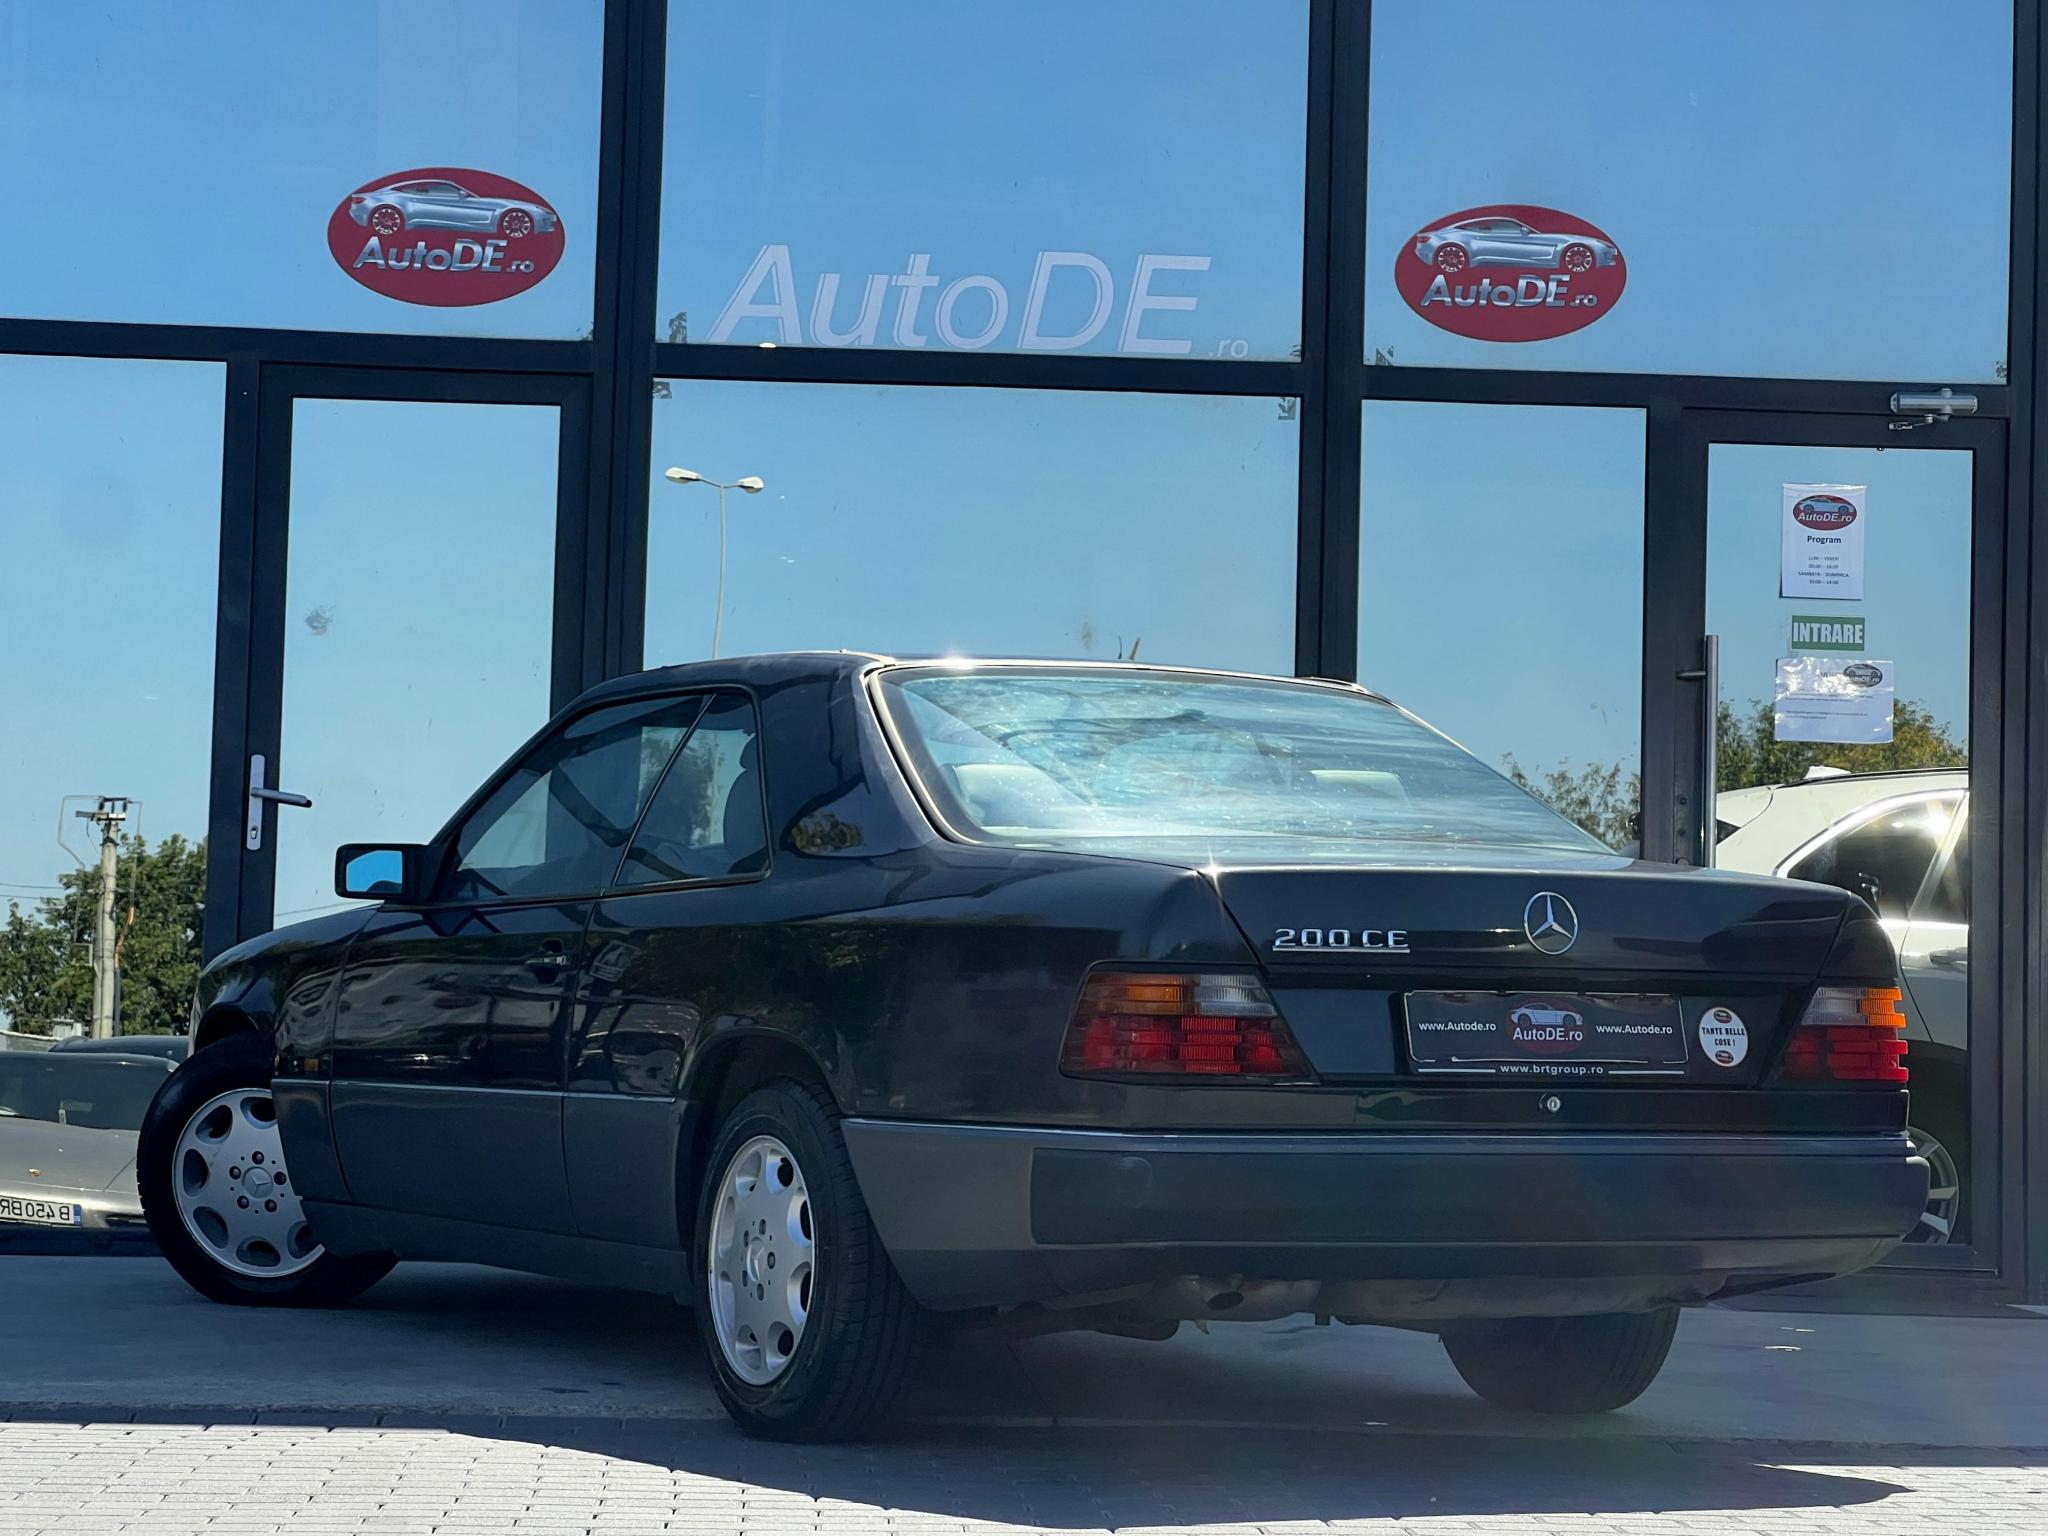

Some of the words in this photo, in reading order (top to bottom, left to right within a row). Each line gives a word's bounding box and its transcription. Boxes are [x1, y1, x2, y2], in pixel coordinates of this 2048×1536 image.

[352, 235, 535, 273] AutoDE.ro
[1420, 273, 1599, 307] AutoDE.ro
[1797, 512, 1853, 522] AutoDE.ro
[1807, 535, 1842, 545] Program
[1793, 622, 1864, 644] INTRARE
[1274, 928, 1350, 948] 200
[1362, 930, 1409, 948] CE
[1418, 1021, 1497, 1031] www.Autode.ro
[1512, 1027, 1583, 1041] AutoDE.ro
[1596, 1024, 1673, 1034] www.Autode.ro
[1701, 1027, 1723, 1035] TANTE
[1725, 1027, 1745, 1036] BELLE
[1499, 1063, 1604, 1076] www.brtgroup.ro
